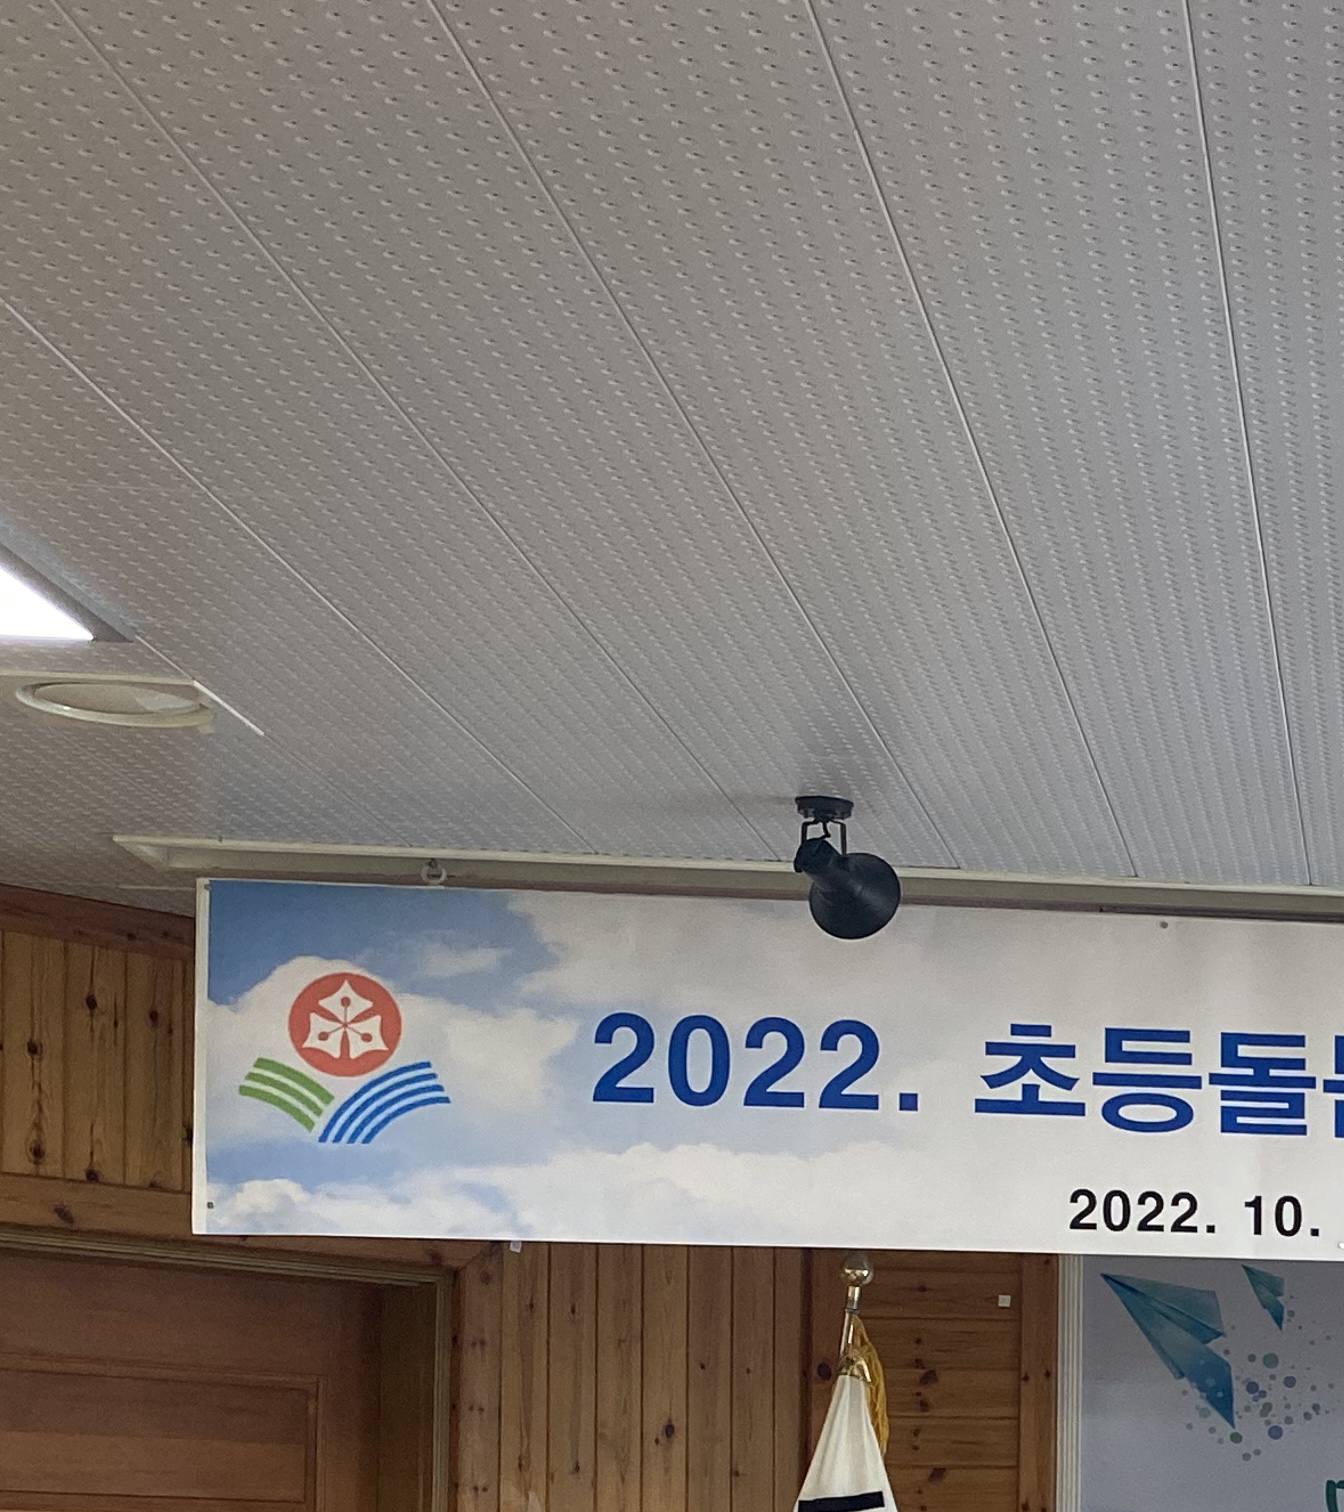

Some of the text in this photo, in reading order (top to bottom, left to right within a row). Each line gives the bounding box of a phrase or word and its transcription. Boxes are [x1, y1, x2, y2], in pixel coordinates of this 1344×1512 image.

[593, 1012, 918, 1111] 2022.
[1069, 1189, 1215, 1233] 2022.
[1245, 1196, 1319, 1237] 10.
